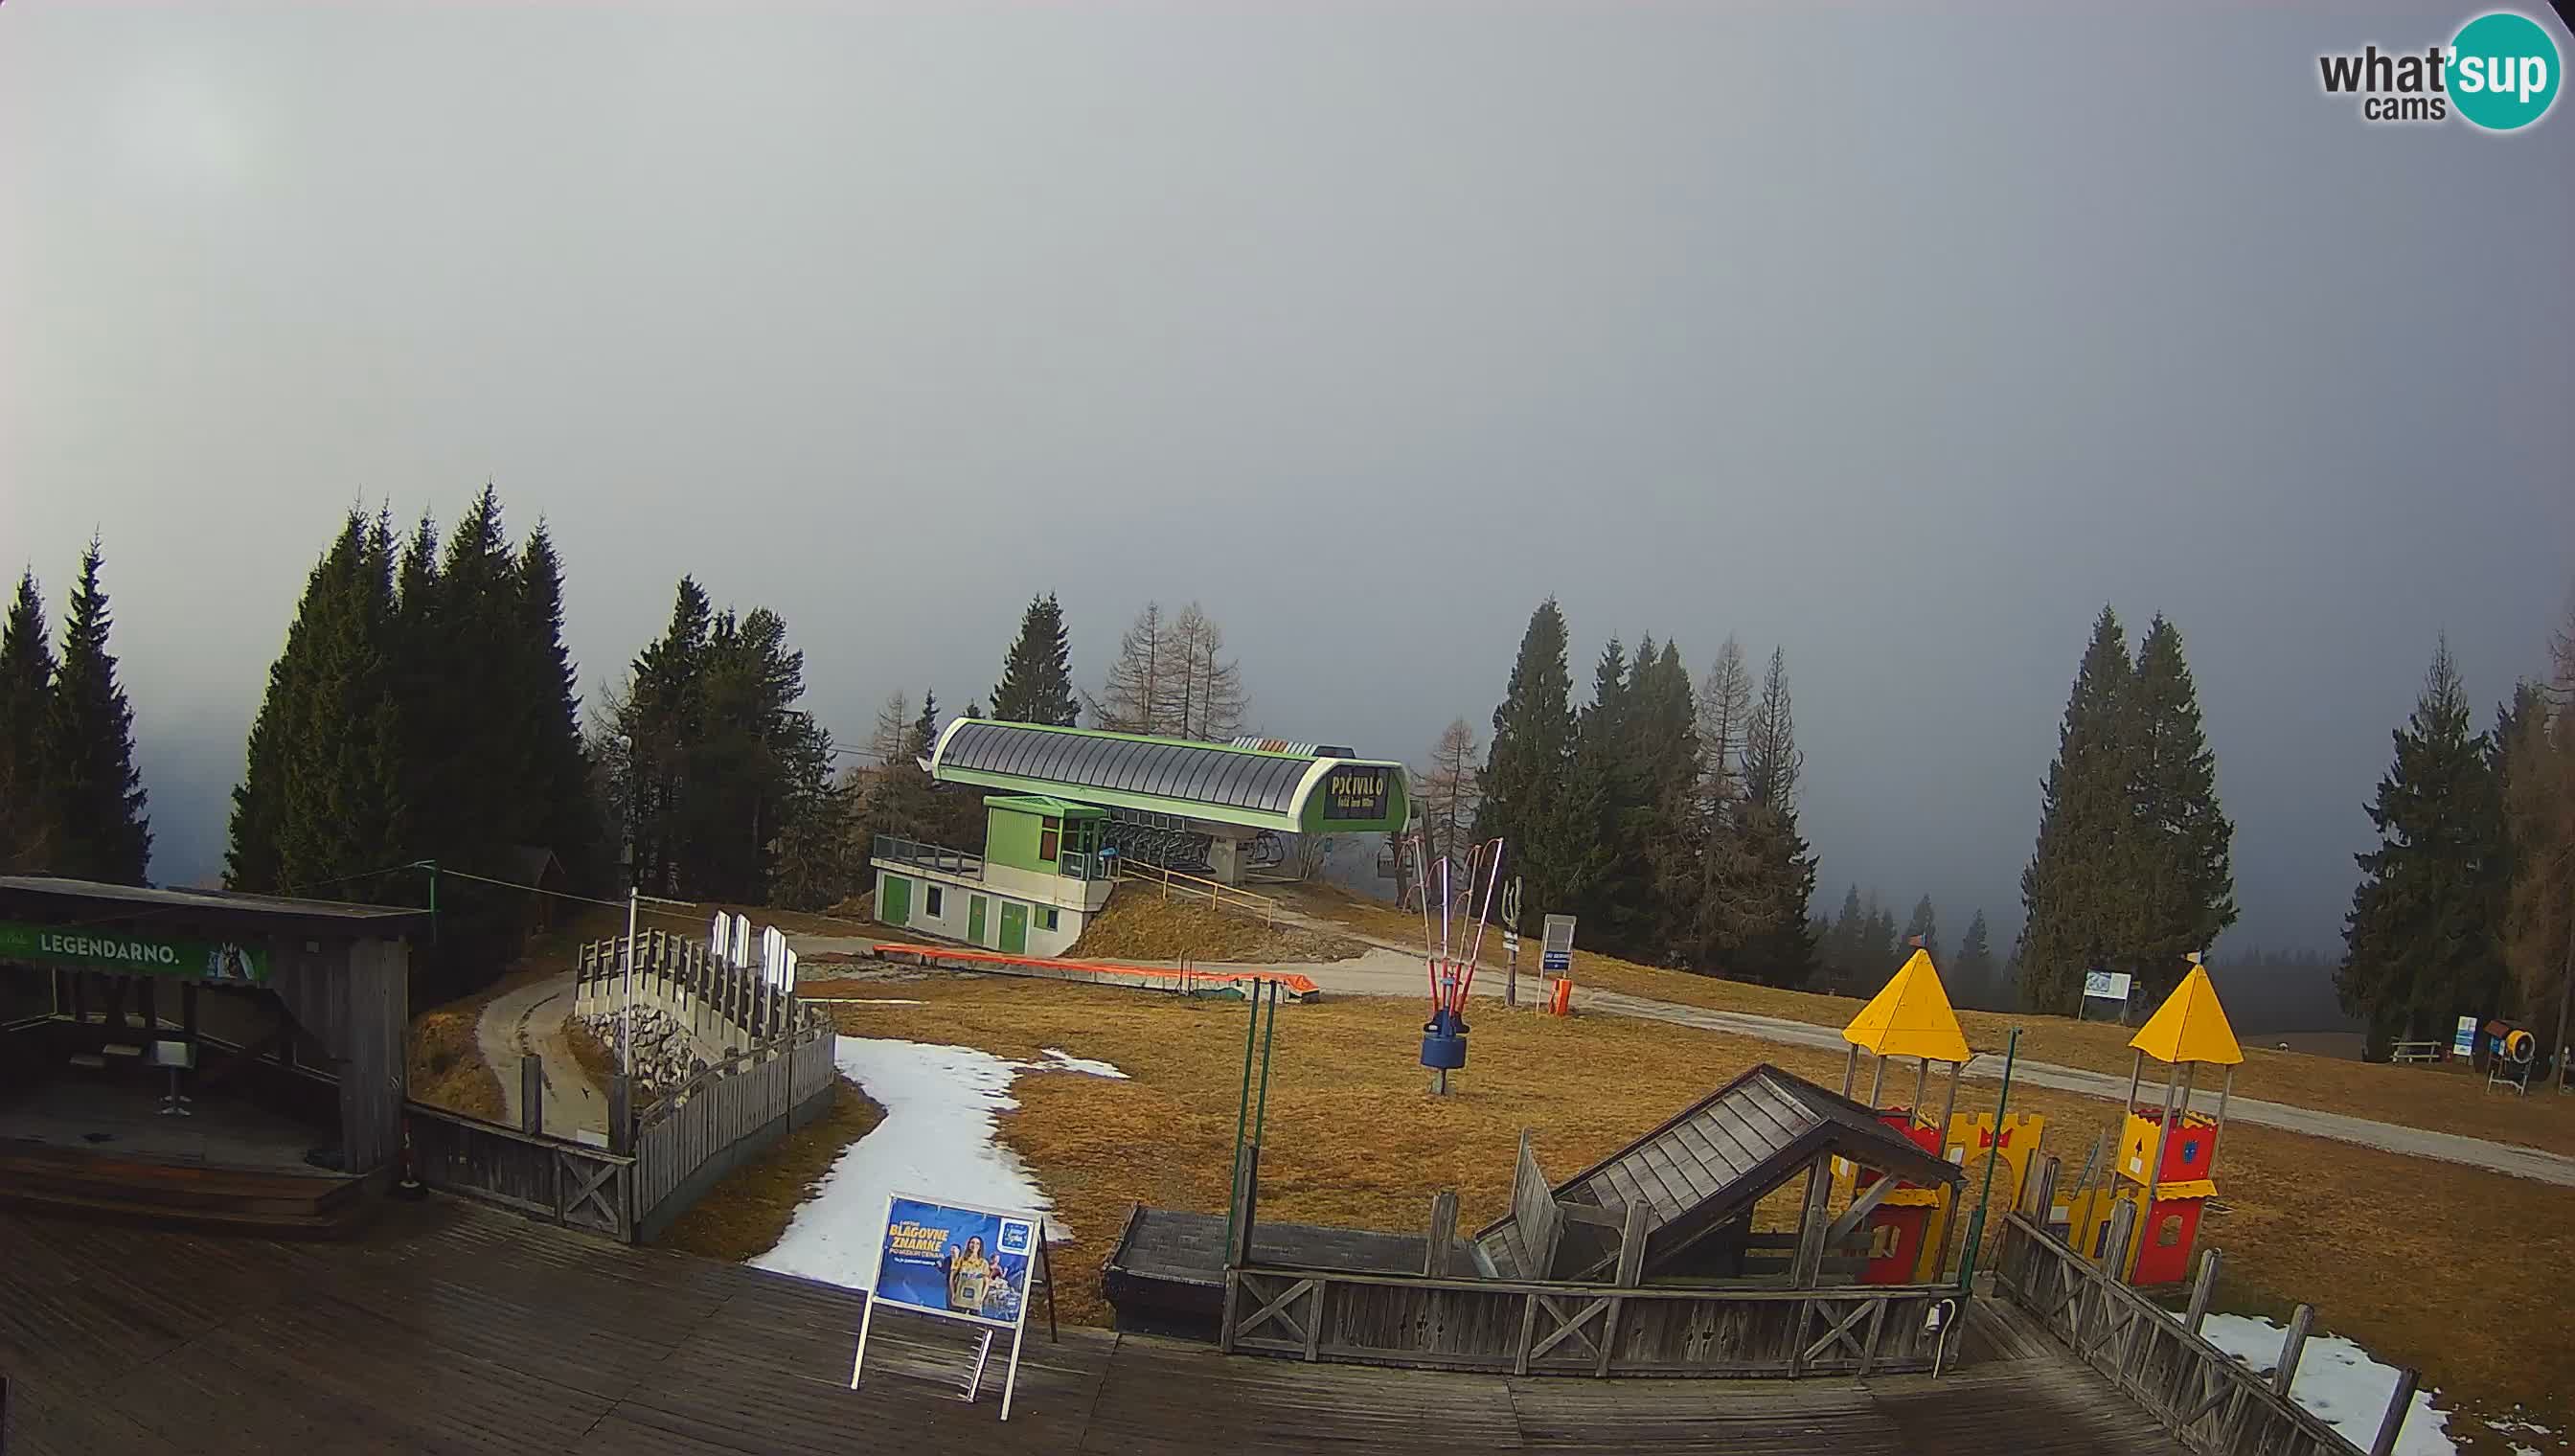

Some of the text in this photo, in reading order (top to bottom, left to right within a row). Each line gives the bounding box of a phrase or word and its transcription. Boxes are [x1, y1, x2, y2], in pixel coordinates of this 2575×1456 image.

[40, 933, 181, 965] LEGENDARNO.
[889, 1223, 950, 1242] BLAGOVNE
[891, 1237, 944, 1253] ZNAMKE
